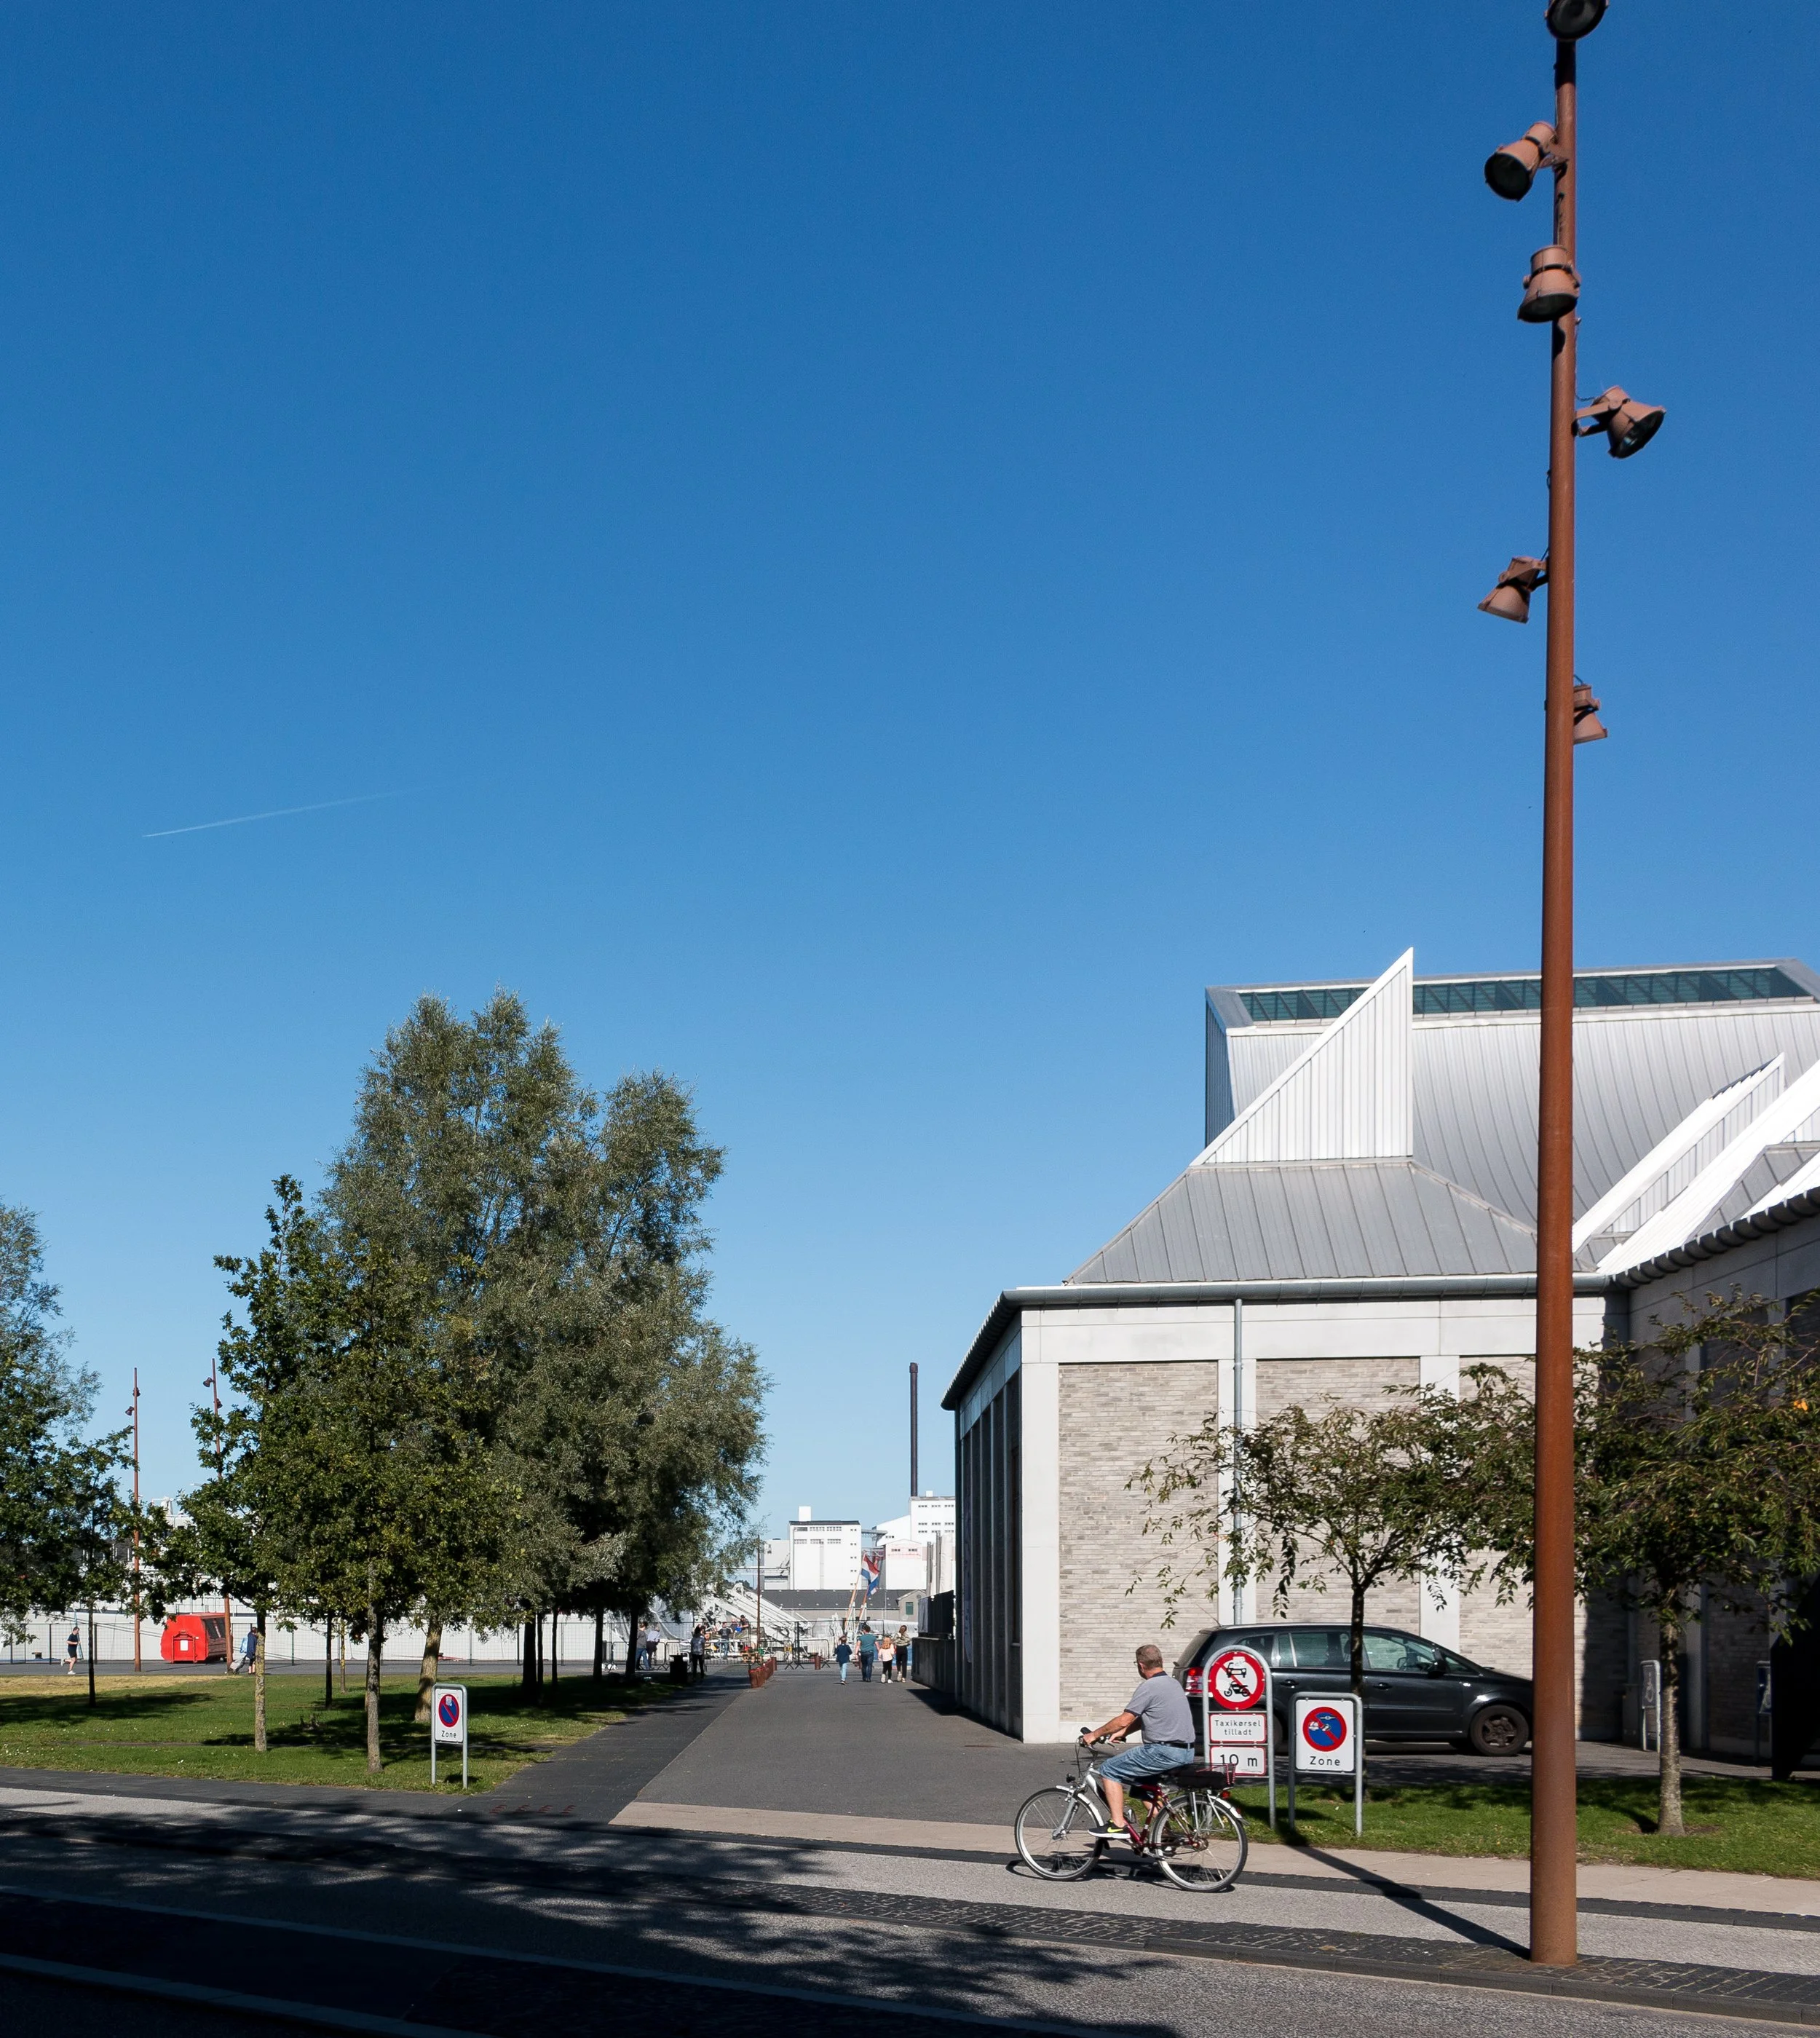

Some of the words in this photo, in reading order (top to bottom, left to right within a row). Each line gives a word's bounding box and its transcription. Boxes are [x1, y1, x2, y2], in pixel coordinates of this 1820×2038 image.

[441, 1730, 457, 1739] Zone
[1219, 1753, 1239, 1766] 10
[1247, 1757, 1258, 1767] m
[1310, 1755, 1341, 1766] Zone
